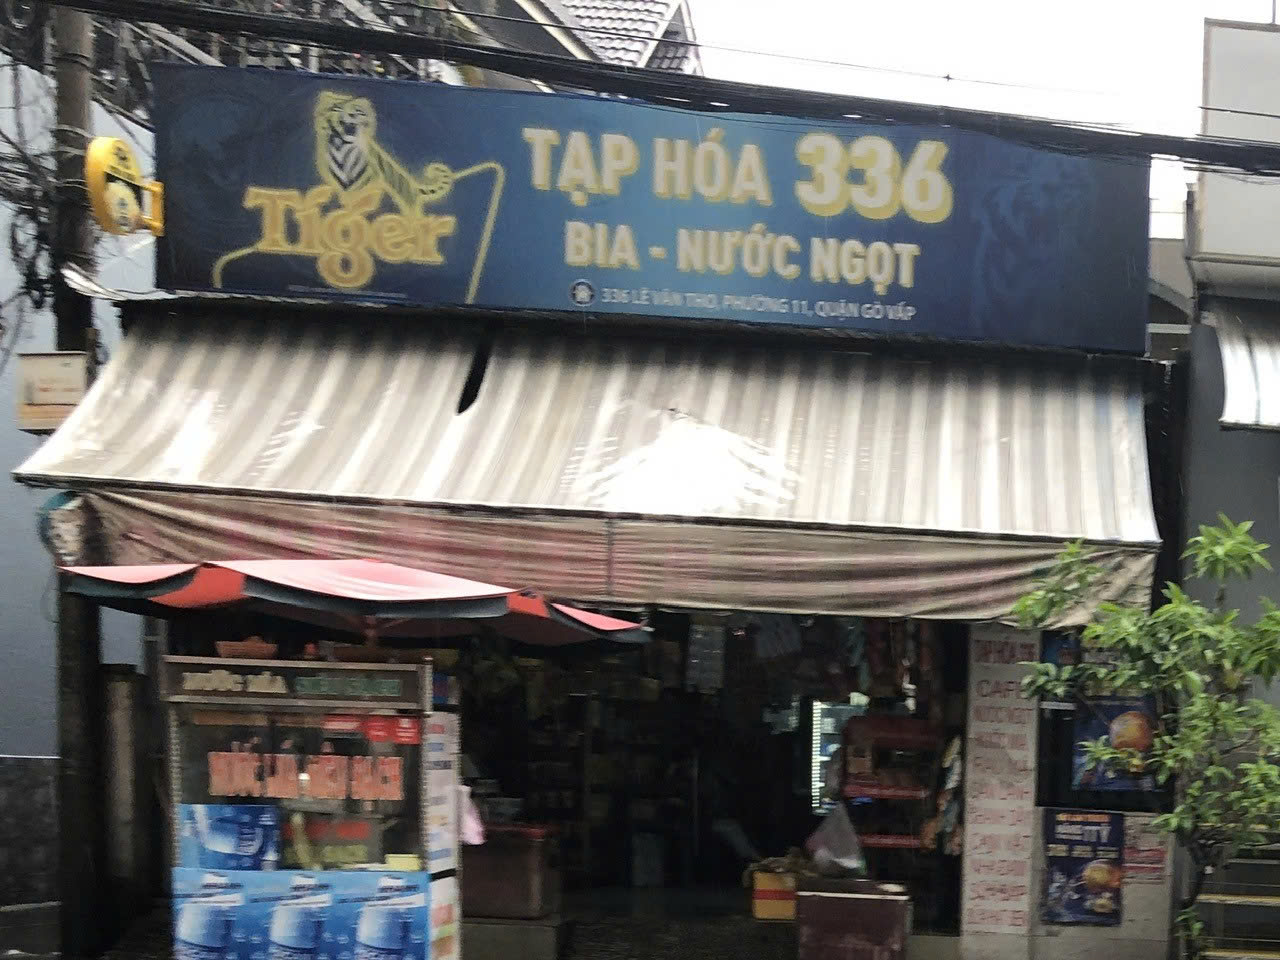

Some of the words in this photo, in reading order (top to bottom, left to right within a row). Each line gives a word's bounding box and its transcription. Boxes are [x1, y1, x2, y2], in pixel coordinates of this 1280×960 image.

[523, 126, 637, 206] TẠP
[652, 127, 772, 206] HÓA
[794, 131, 955, 224] 336
[243, 185, 457, 289] Tiger
[564, 220, 641, 270] BIA
[676, 222, 802, 280] NƯỚC
[810, 238, 921, 296] NGỌT
